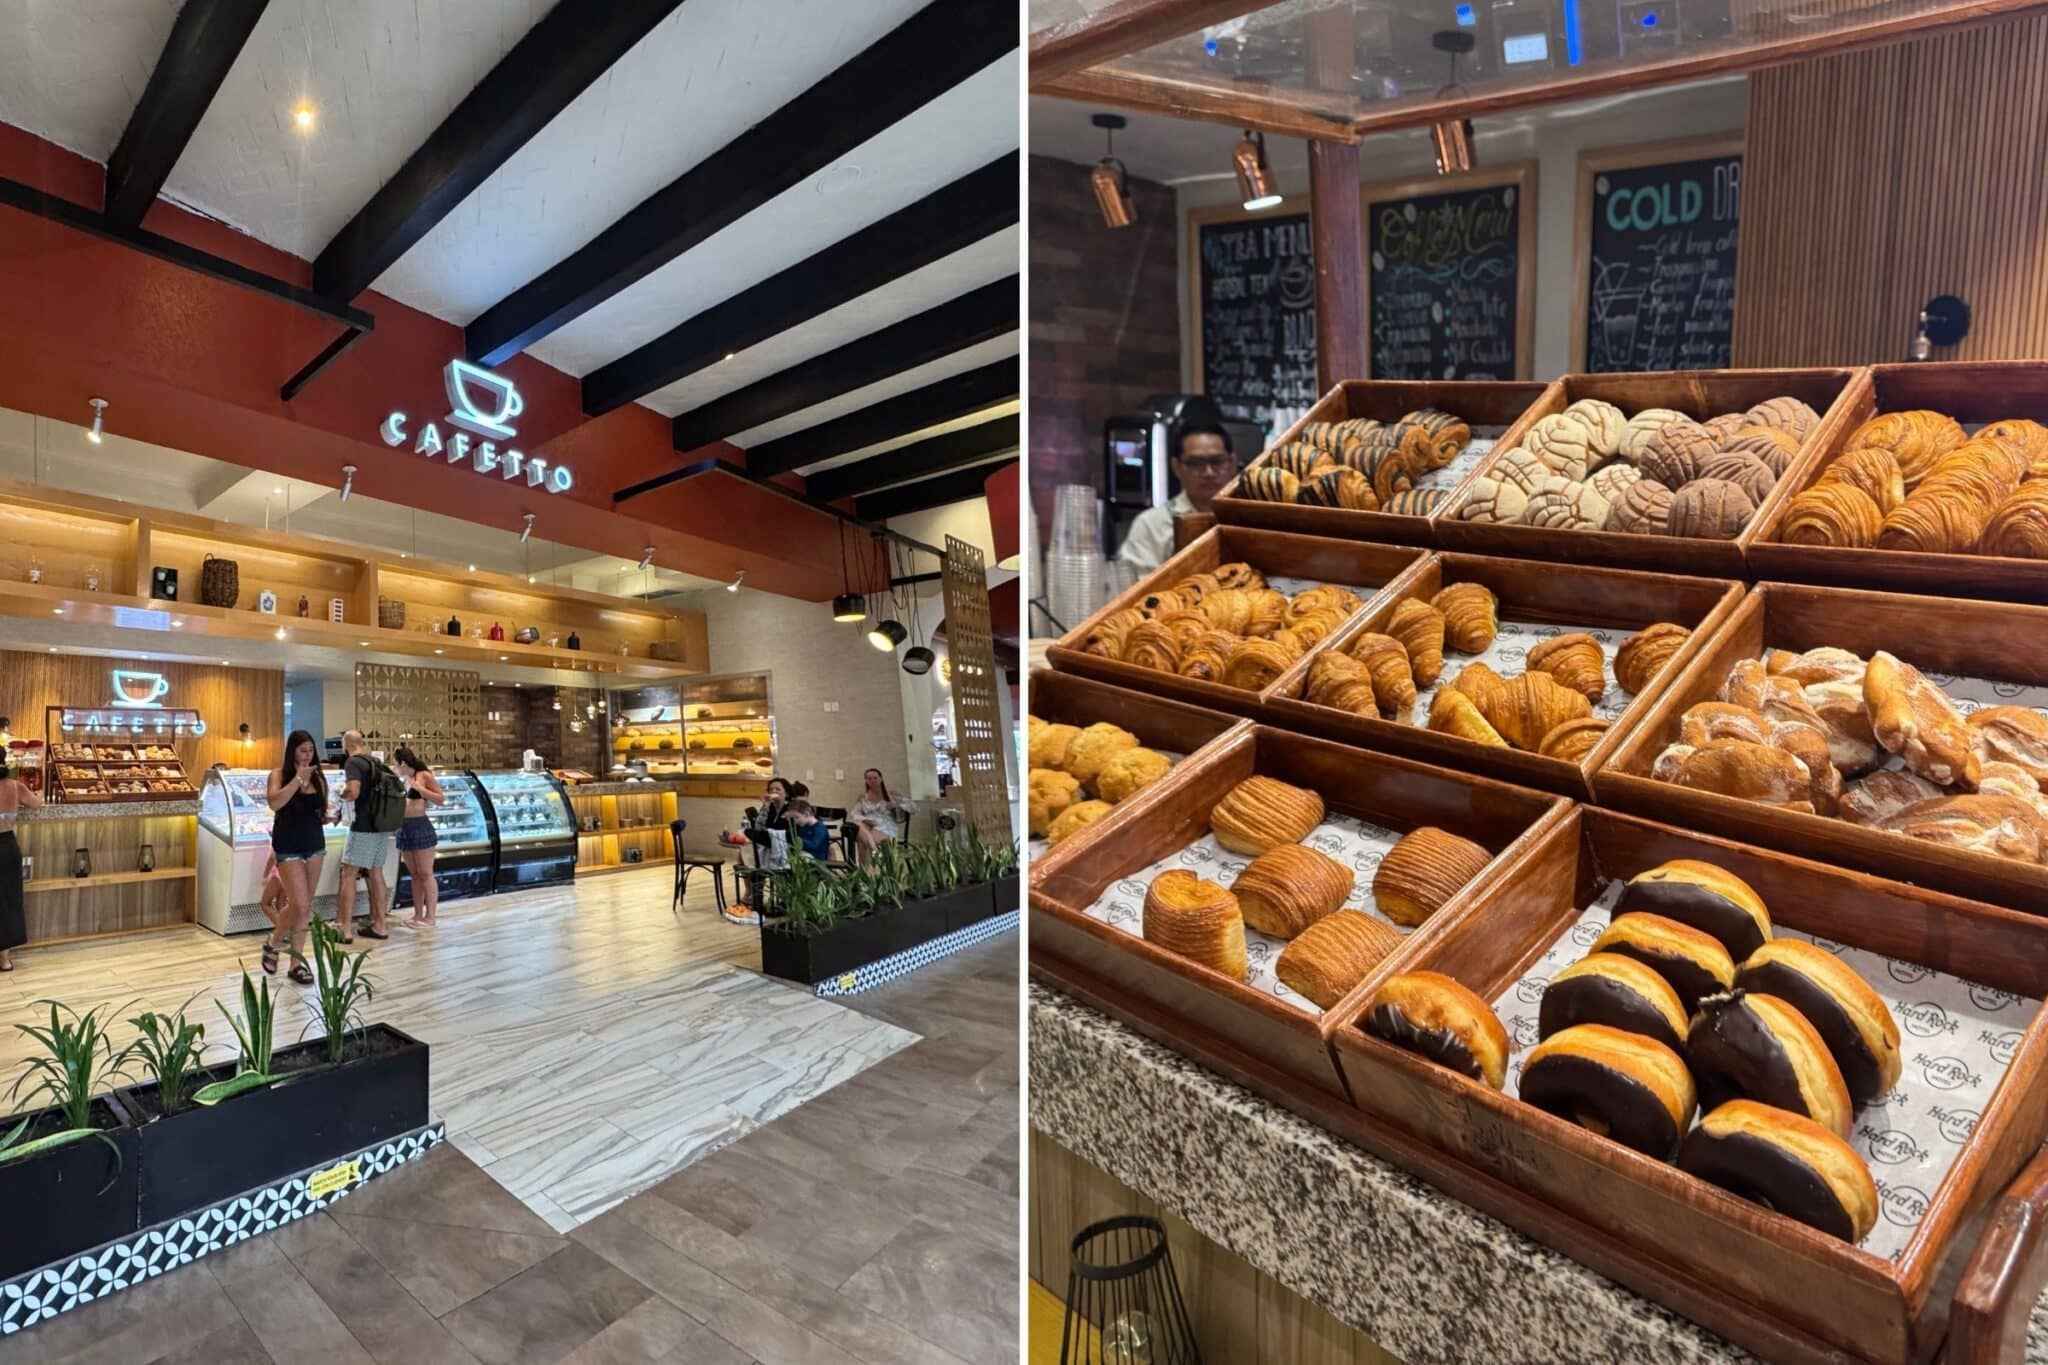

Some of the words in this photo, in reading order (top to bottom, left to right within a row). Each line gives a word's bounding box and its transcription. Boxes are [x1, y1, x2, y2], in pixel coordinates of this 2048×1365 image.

[1606, 179, 1703, 231] COLD
[1220, 229, 1258, 263] TEA
[380, 412, 572, 494] CAFETTO
[61, 713, 206, 736] CAFETTO
[1893, 1000, 1927, 1020] Hard
[1925, 1008, 1959, 1035] Rock
[1977, 1030, 2016, 1050] Hard
[1912, 1053, 1949, 1073] Hard
[1948, 1066, 1982, 1088] Rock
[1927, 1105, 1967, 1127] Hard
[1858, 1125, 1897, 1147] Hard
[1894, 1141, 1929, 1163] Rock
[1875, 1179, 1912, 1207] Hard
[1909, 1199, 1928, 1217] Ro
